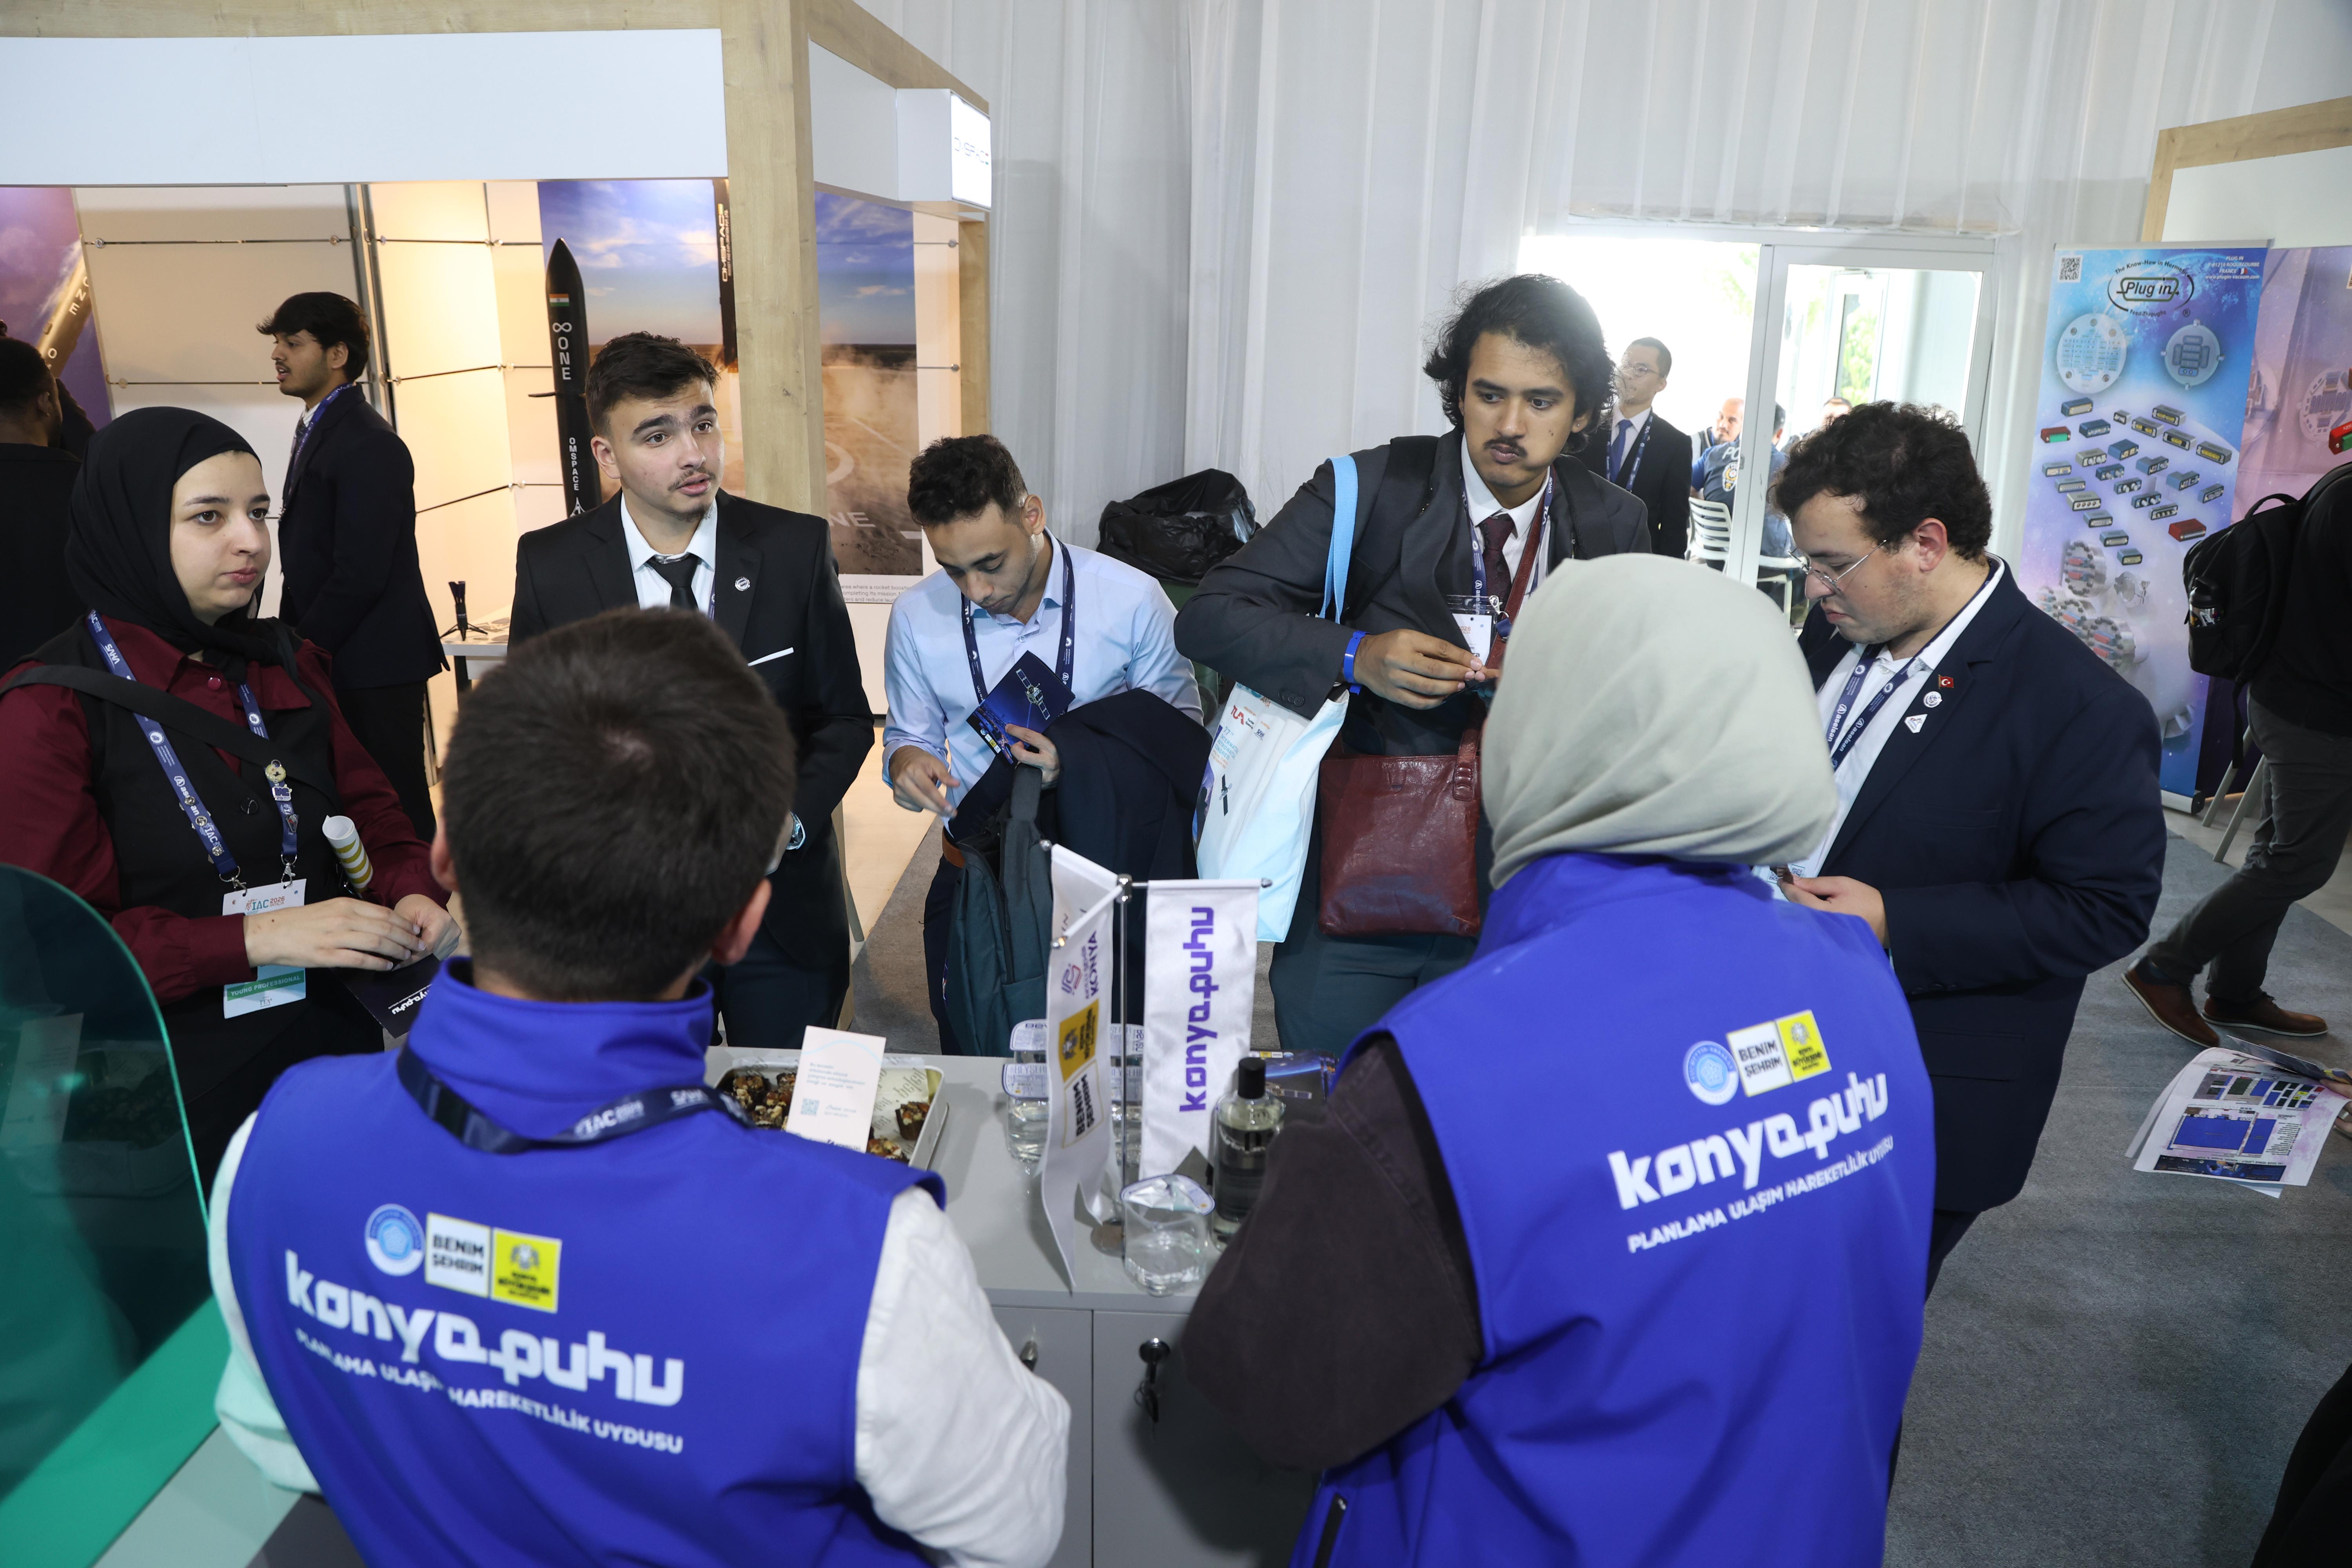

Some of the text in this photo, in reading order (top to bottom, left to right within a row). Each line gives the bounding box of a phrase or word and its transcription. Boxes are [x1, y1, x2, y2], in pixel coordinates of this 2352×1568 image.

[2127, 260, 2156, 269] Know-How
[2165, 261, 2189, 276] Hermetic
[2127, 281, 2156, 298] Plug
[557, 336, 572, 380] ONE
[569, 437, 580, 491] OMSPACE
[105, 643, 120, 665] SAHA
[1231, 704, 1244, 726] TUA
[1243, 706, 1254, 715] HOSTED
[1828, 714, 1842, 742] aselsan
[1839, 726, 1857, 752] aselsan
[157, 746, 167, 763] FEDERATION
[163, 745, 176, 766] INTERNATIONAL
[1215, 745, 1230, 760] CONGRESS
[204, 827, 218, 843] IAC
[252, 899, 269, 911] IAC
[1087, 931, 1099, 997] KONYA
[231, 975, 301, 996] YOUNG PROFESSIONAL
[1738, 1040, 1778, 1062] BENİM
[1744, 1056, 1783, 1078] ŞEHRİM
[1073, 1081, 1085, 1136] BENİM
[1081, 1073, 1095, 1129] ŞEHRİM
[585, 1109, 617, 1134] IAC
[1628, 1135, 1894, 1254] PLANLAMA ULAŞIM HAREKETLİLİK UYDUSU
[433, 1234, 484, 1258] BENİM
[432, 1254, 483, 1275] ŞEHRİM
[295, 1327, 377, 1377] PLANLAMA
[447, 1386, 591, 1435] HAREKETLİLİK
[593, 1419, 684, 1454] UYDUSU
